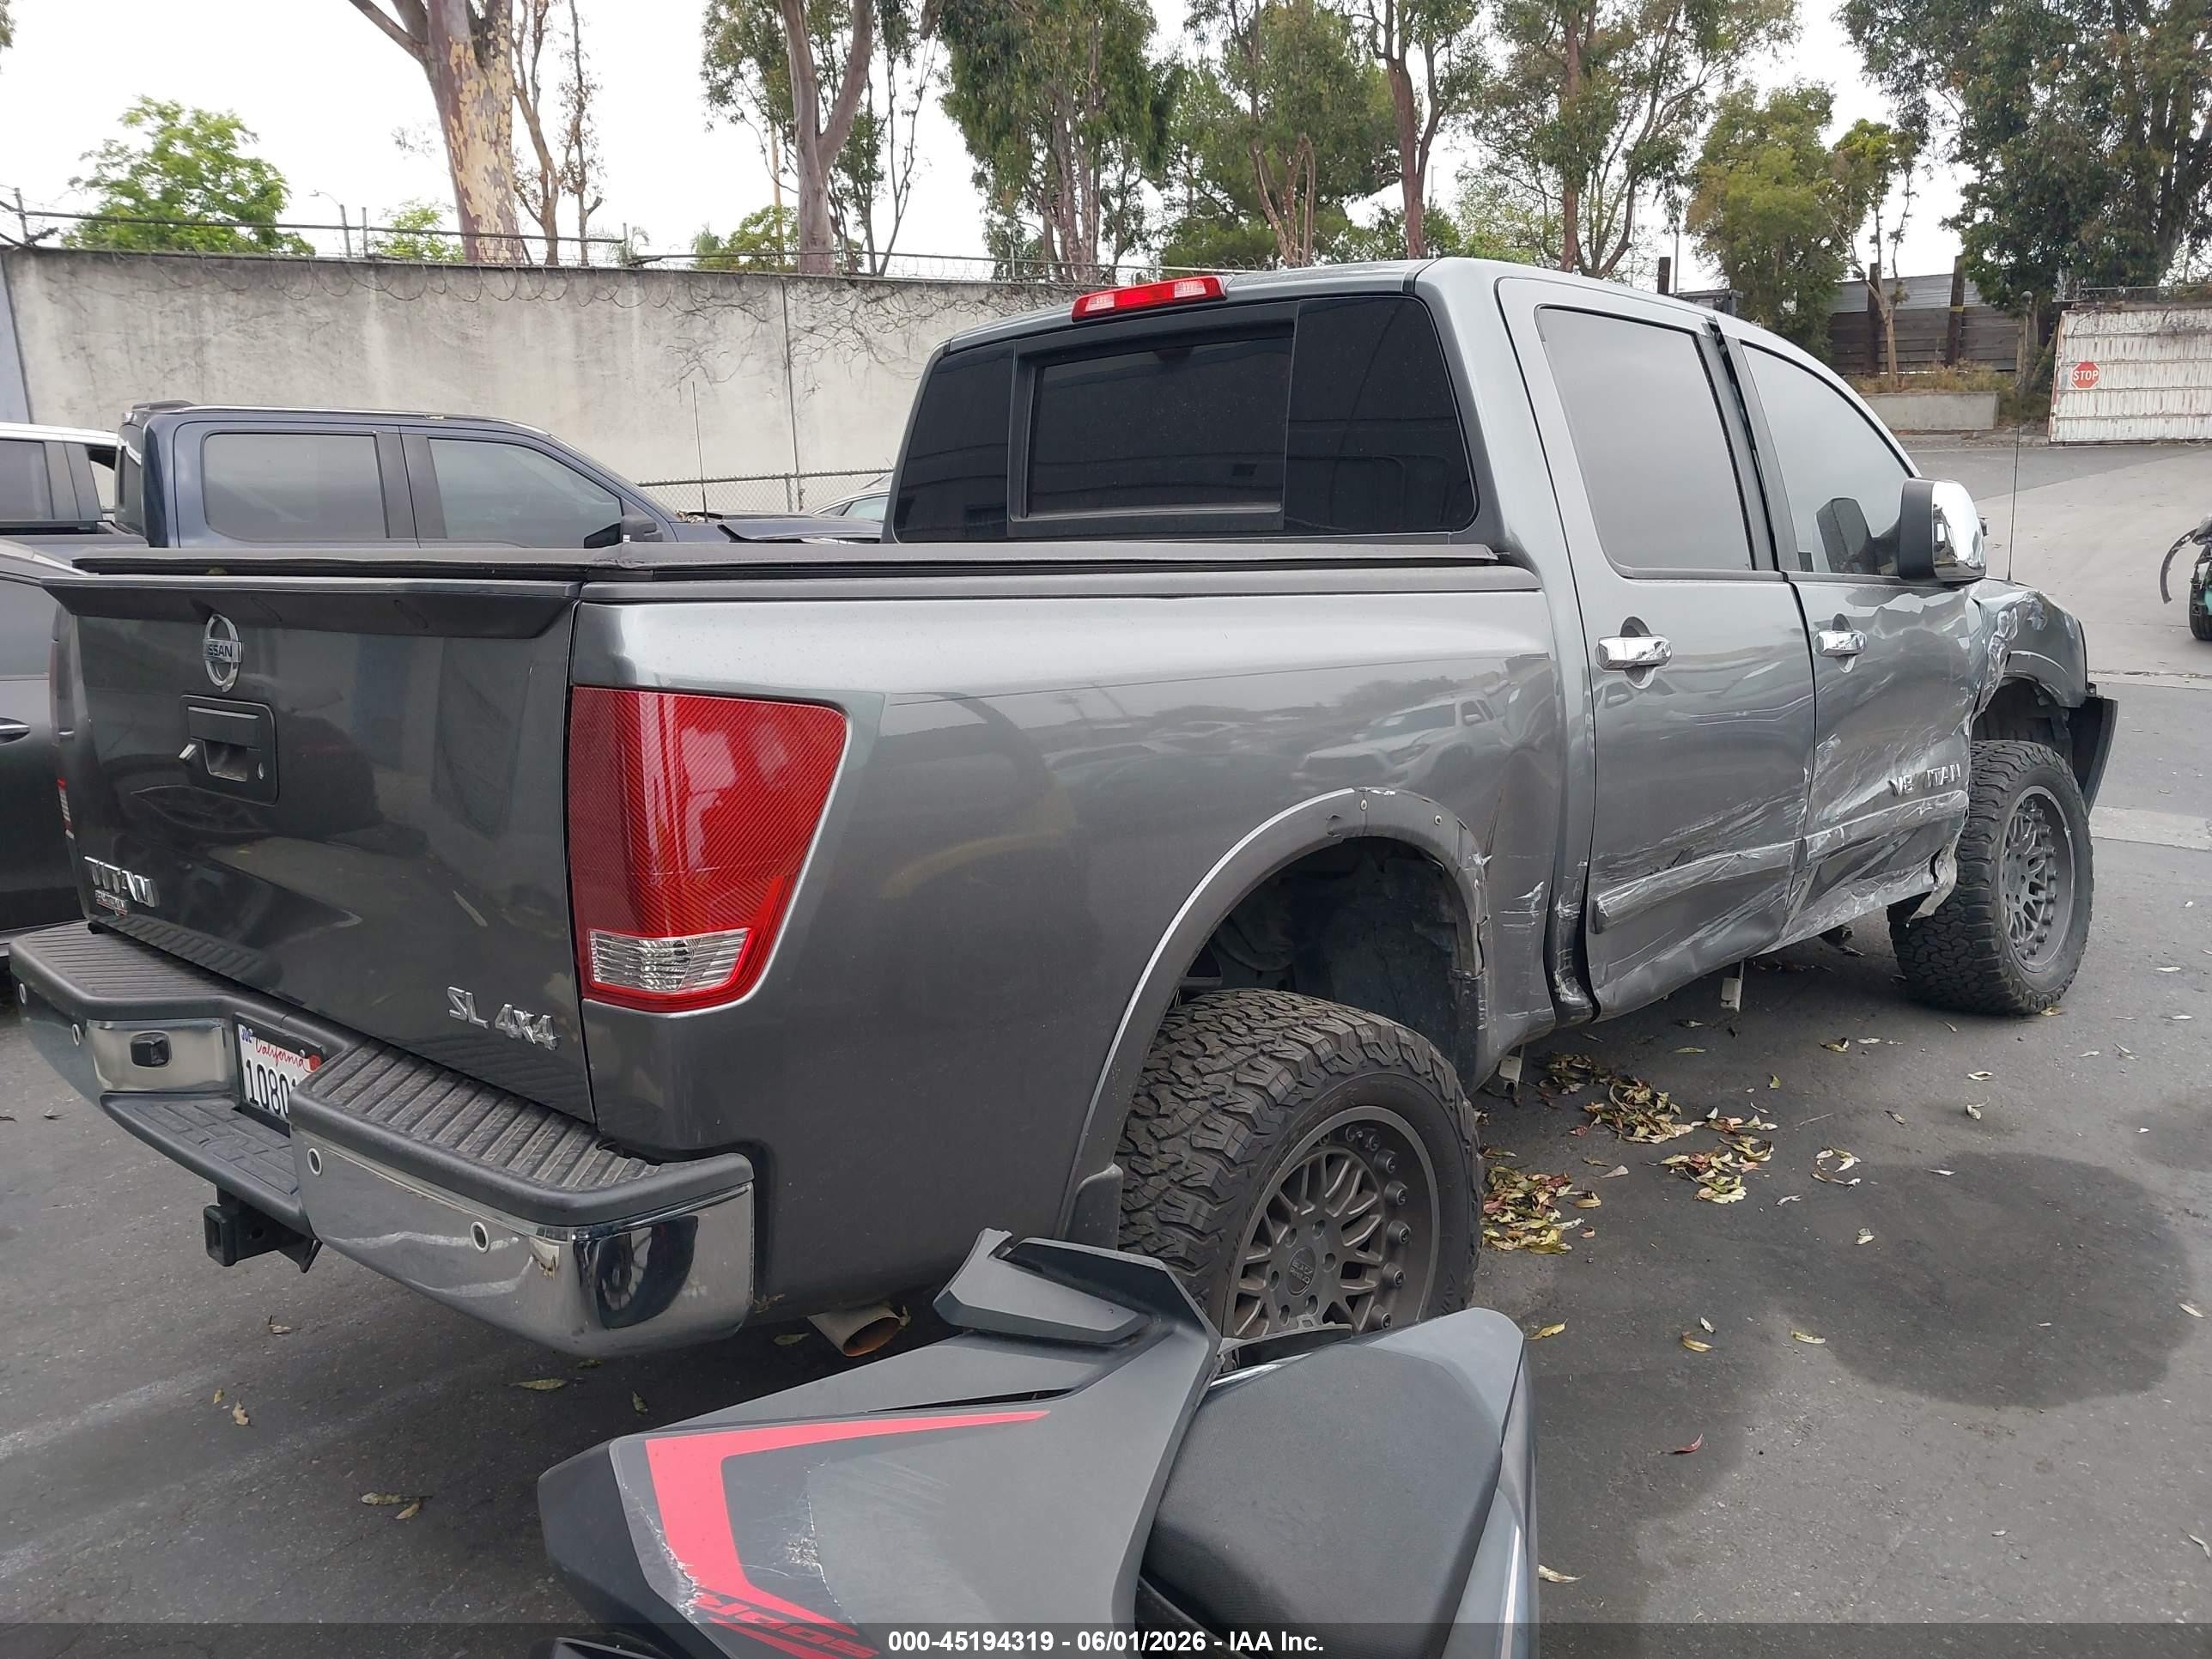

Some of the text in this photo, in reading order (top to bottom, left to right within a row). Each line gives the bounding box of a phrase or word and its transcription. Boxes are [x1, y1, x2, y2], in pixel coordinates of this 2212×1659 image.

[2073, 369, 2100, 381] STOP
[206, 643, 233, 658] SSAN
[84, 855, 158, 908] TITAN
[447, 986, 489, 1030] SL
[255, 1038, 307, 1070] California
[246, 1058, 296, 1119] 1080
